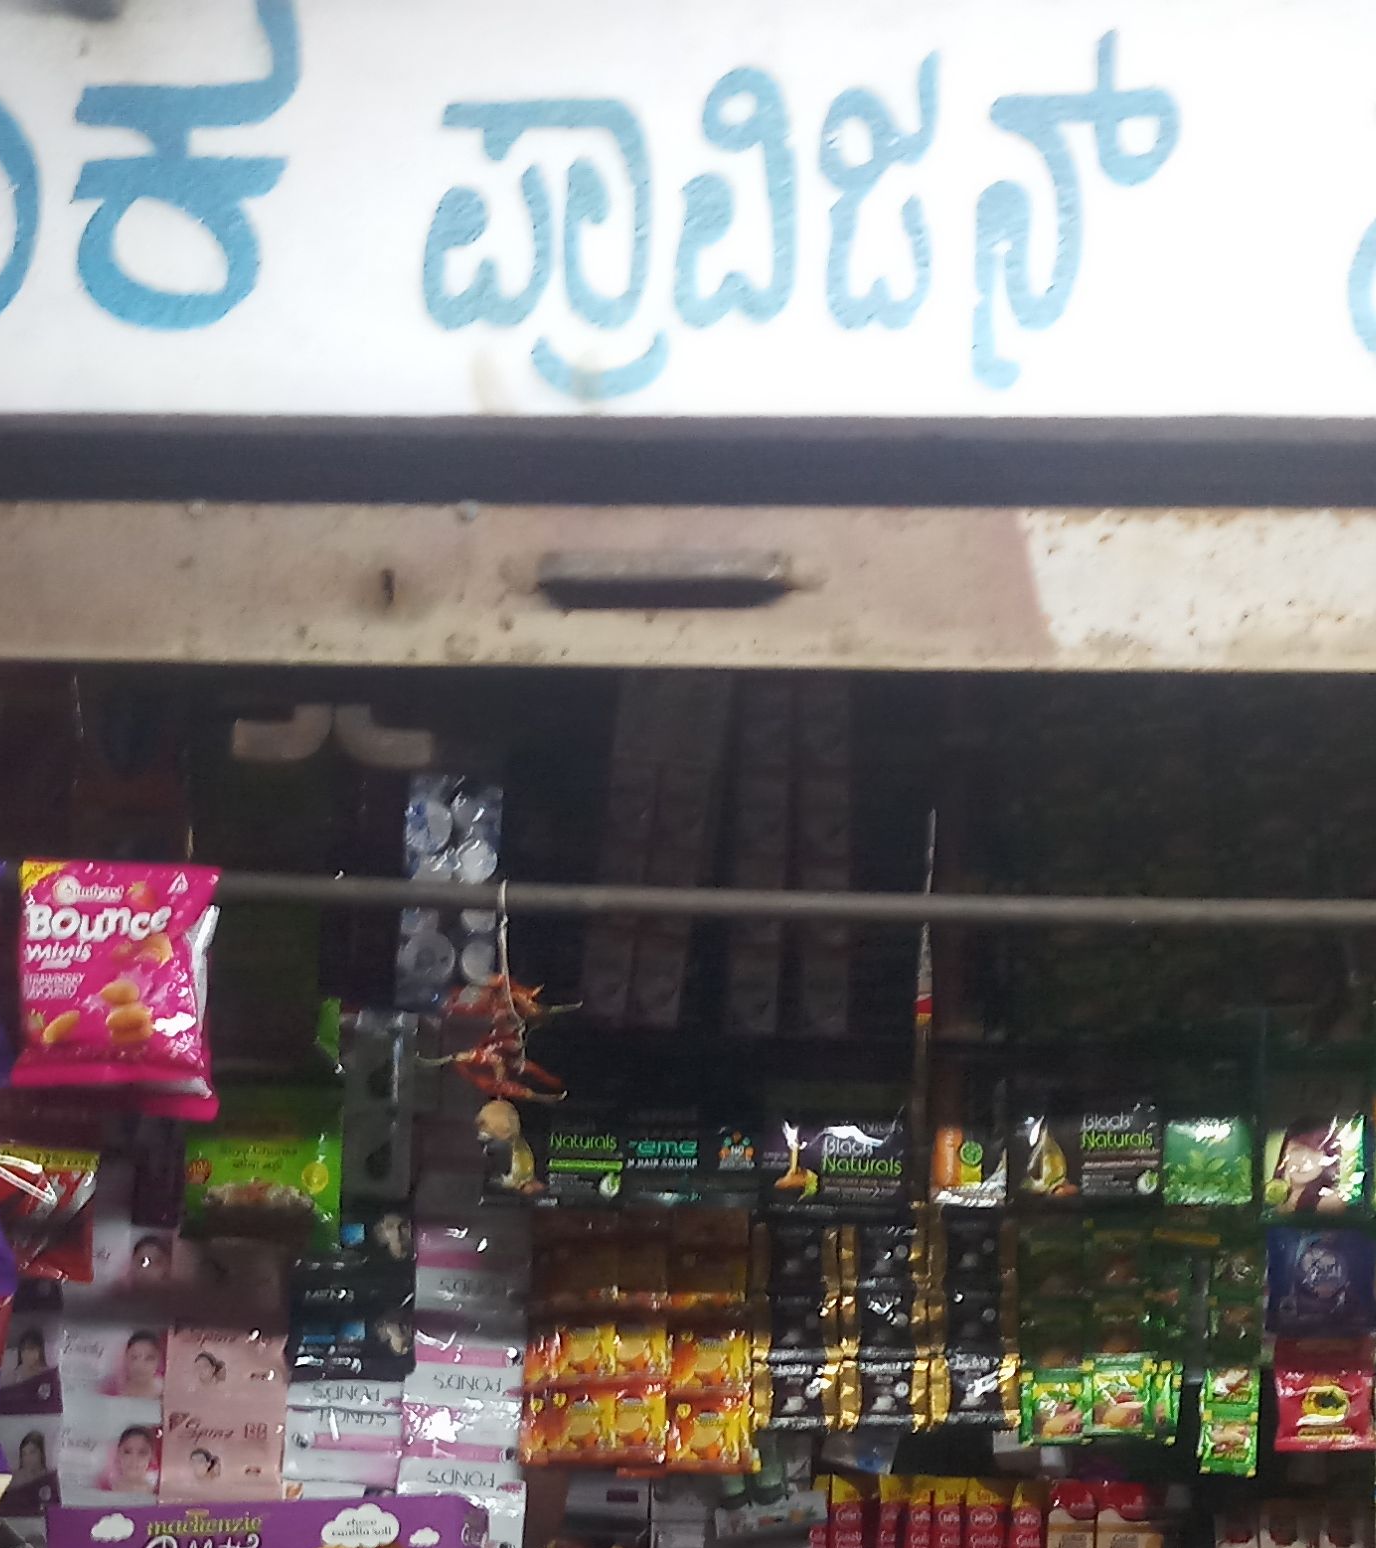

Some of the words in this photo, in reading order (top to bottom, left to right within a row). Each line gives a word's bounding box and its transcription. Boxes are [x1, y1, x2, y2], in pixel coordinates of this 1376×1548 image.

[1081, 1130, 1154, 1150] Naturals
[822, 1155, 903, 1177] Naturals
[244, 1422, 268, 1441] BB
